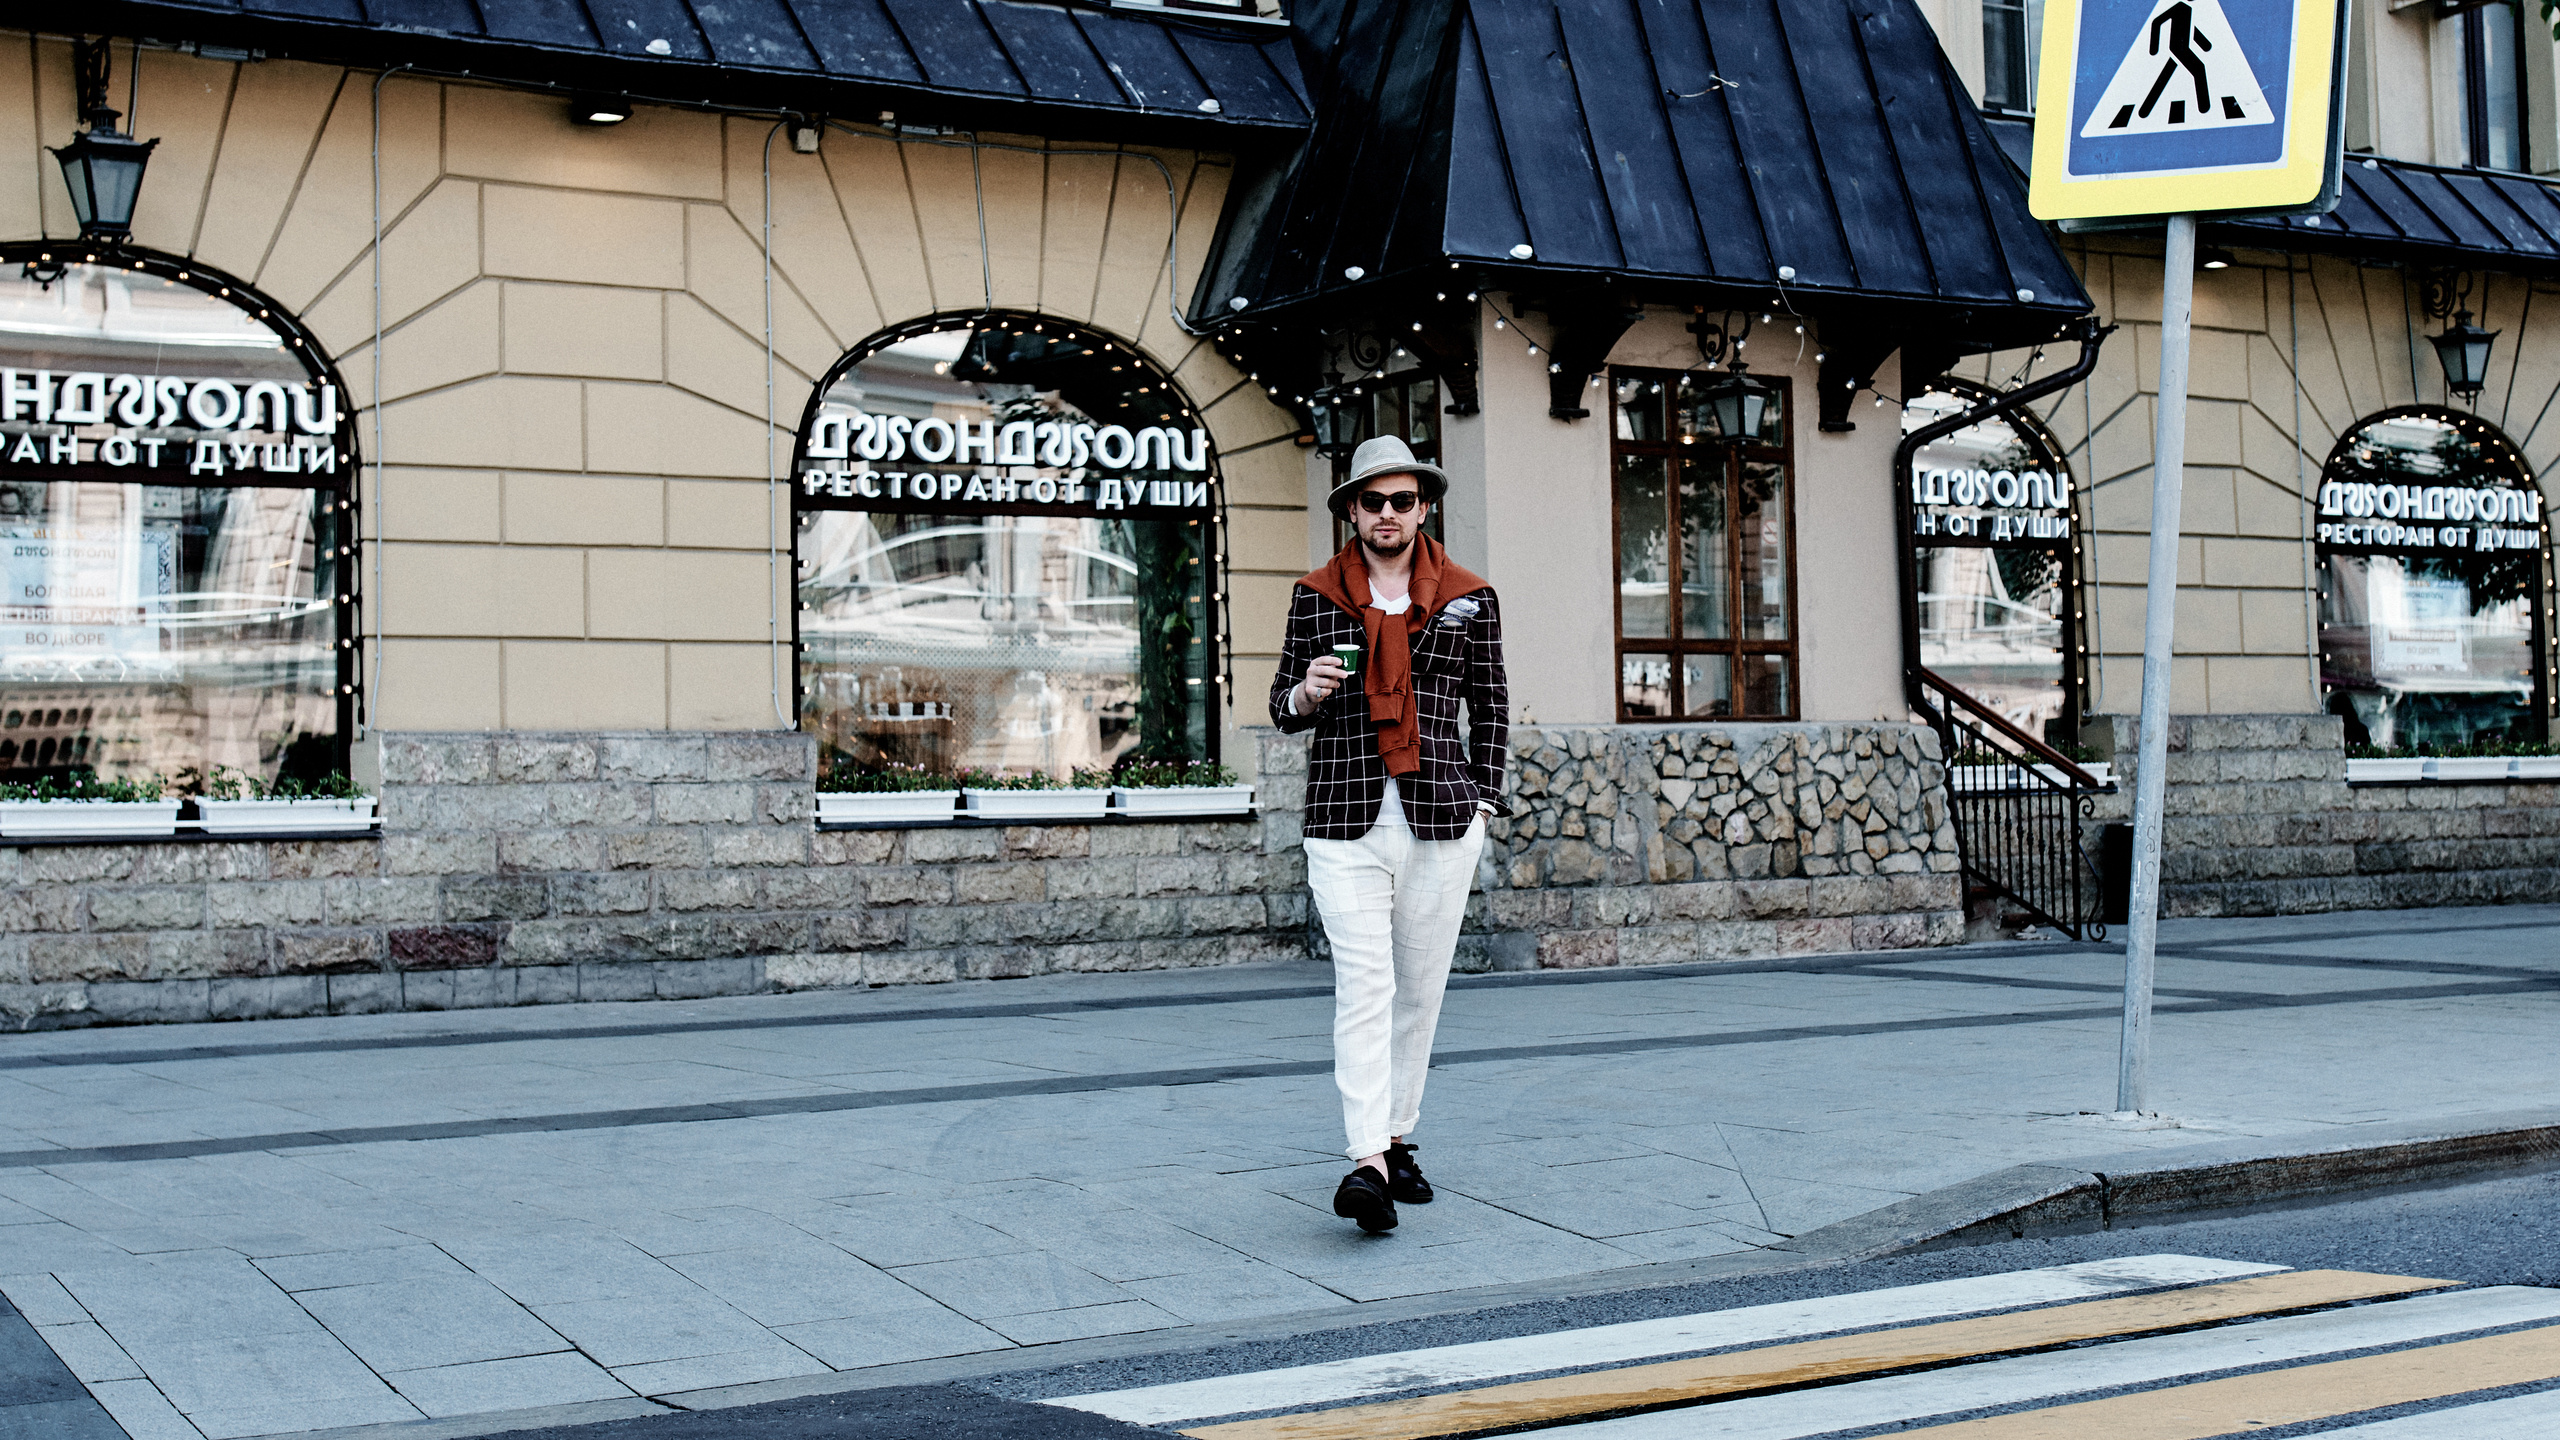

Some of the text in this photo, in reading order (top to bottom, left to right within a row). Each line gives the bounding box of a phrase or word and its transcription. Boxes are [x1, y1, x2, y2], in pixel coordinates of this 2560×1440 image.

[0, 431, 336, 476] АН ОТ ДУШИ
[805, 469, 1207, 510] РЕСТОРАН ОТ ДУШИ
[1944, 514, 1982, 537] ОТ
[1990, 515, 2070, 541] ДУШИ
[2317, 522, 2540, 552] РЕСТОРАН ОТ ДУШИ
[25, 631, 48, 645] ВО
